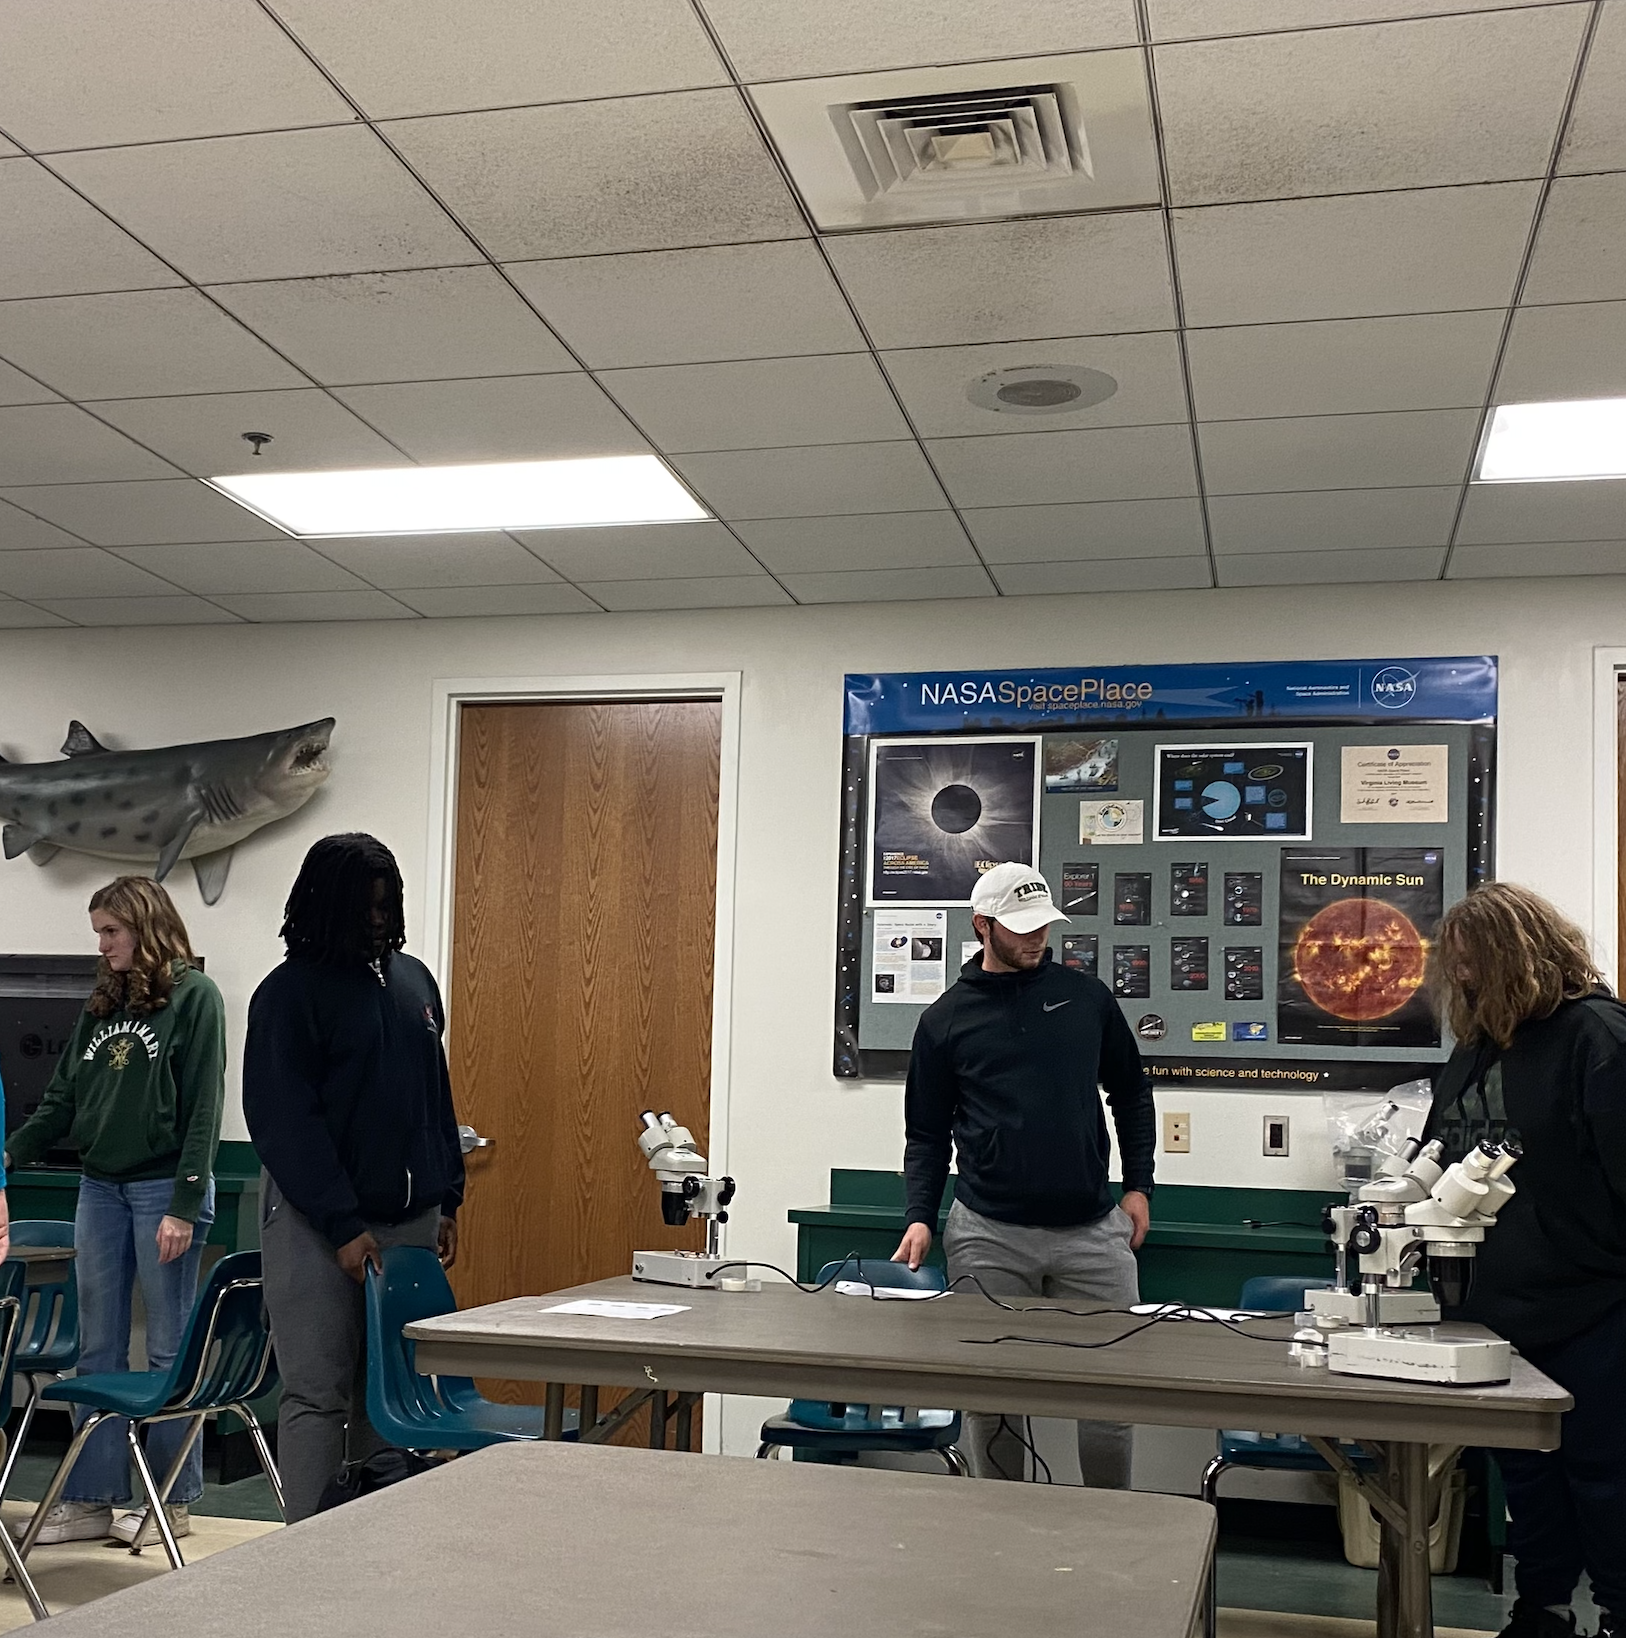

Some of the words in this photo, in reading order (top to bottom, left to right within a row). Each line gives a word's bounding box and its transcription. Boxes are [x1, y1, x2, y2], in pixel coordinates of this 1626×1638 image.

[1375, 683, 1413, 693] NASA
[1028, 702, 1045, 710] visit
[1047, 700, 1142, 711] spaceplace.nasa.gov
[1301, 874, 1327, 886] The
[1331, 873, 1392, 888] Dynamic
[1395, 873, 1424, 886] Sun
[83, 1020, 132, 1061] WILLIAM
[135, 1023, 160, 1061] MARY
[1152, 1066, 1169, 1076] fun
[1170, 1066, 1193, 1077] with
[1195, 1067, 1236, 1078] science
[1238, 1068, 1259, 1079] and
[1261, 1069, 1320, 1082] technology
